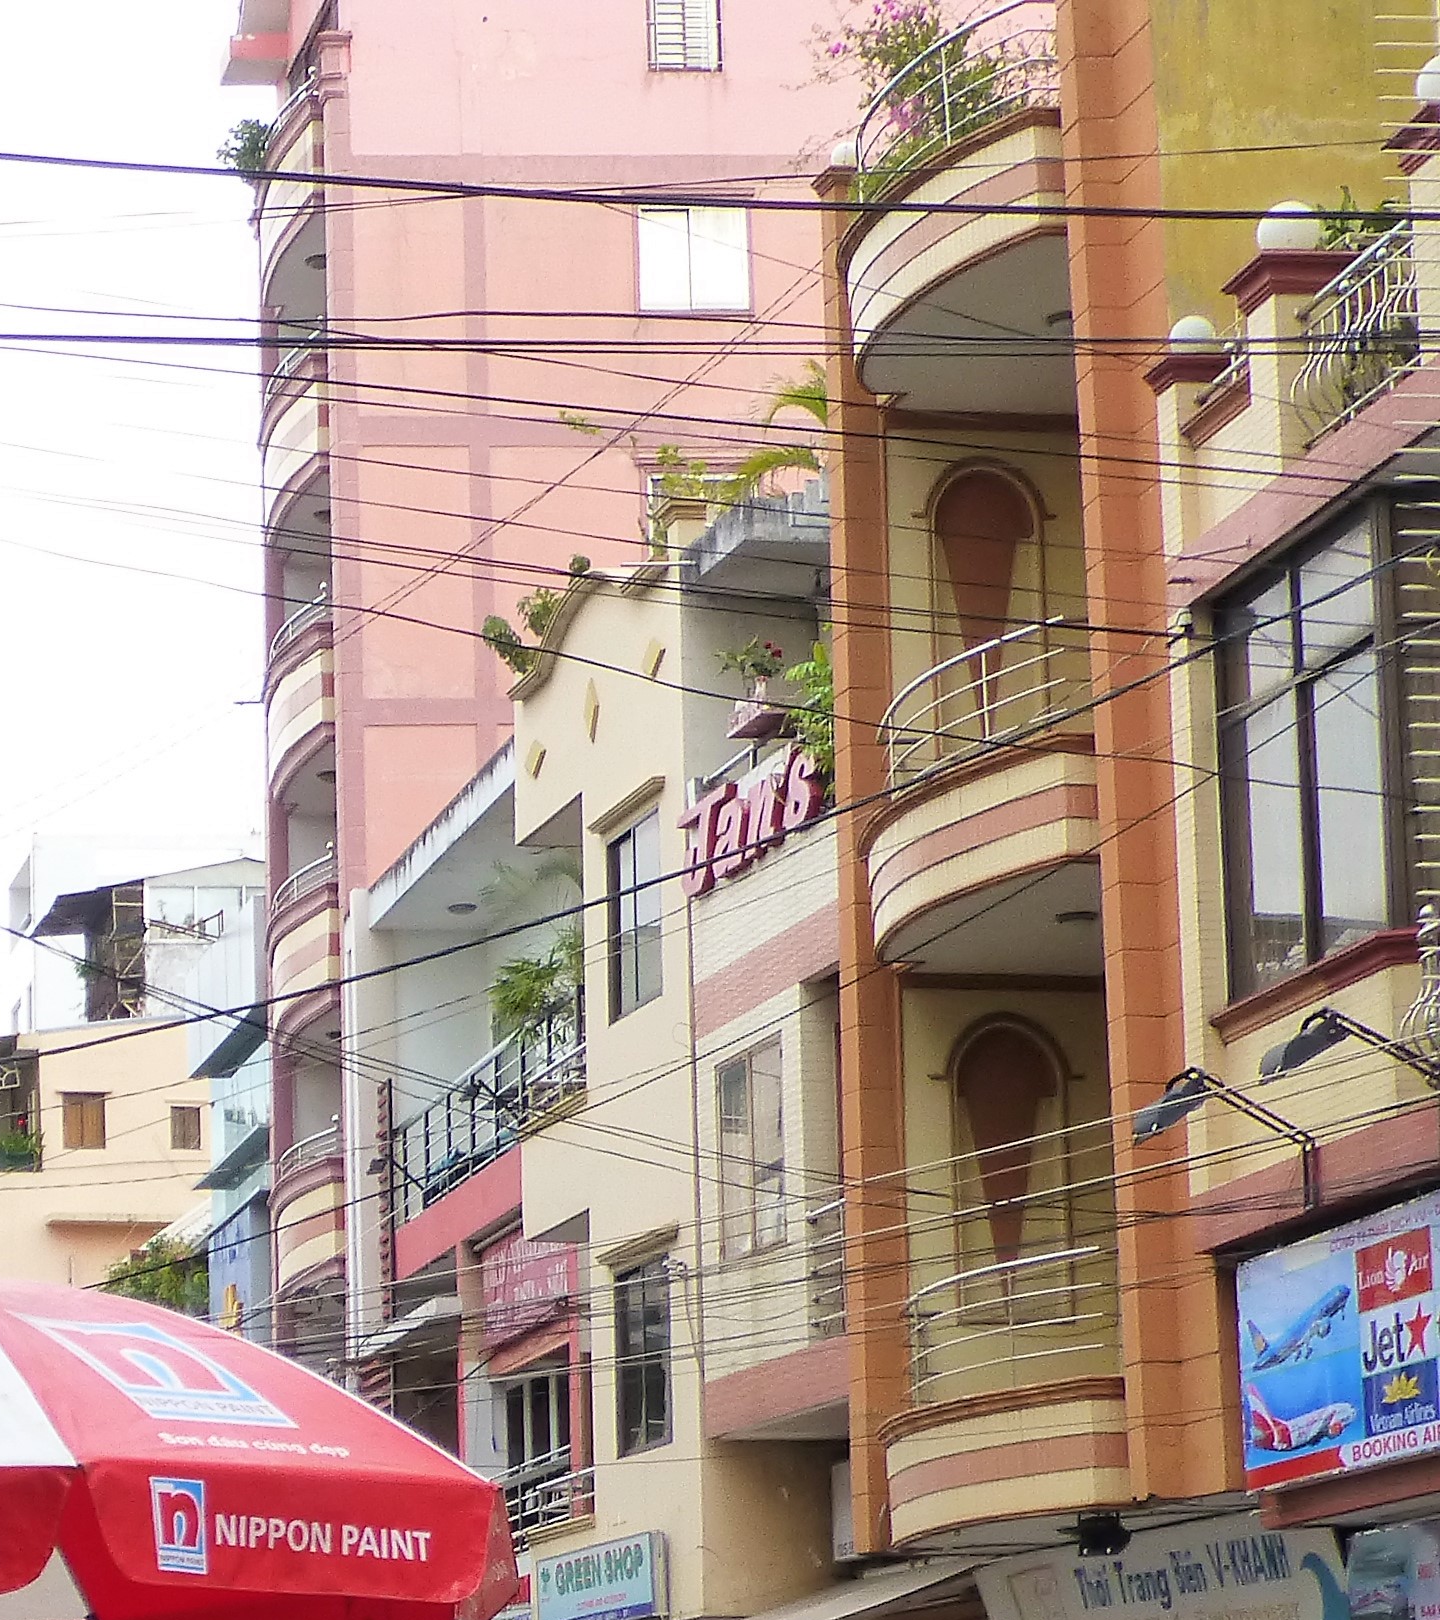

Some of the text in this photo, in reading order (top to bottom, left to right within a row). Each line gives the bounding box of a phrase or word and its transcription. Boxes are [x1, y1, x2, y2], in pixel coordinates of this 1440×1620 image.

[1363, 1312, 1405, 1373] Jet
[1352, 1430, 1419, 1462] BOOKING
[215, 1513, 431, 1563] NIPPON PAINT
[554, 1542, 644, 1596] GREEN SHOP
